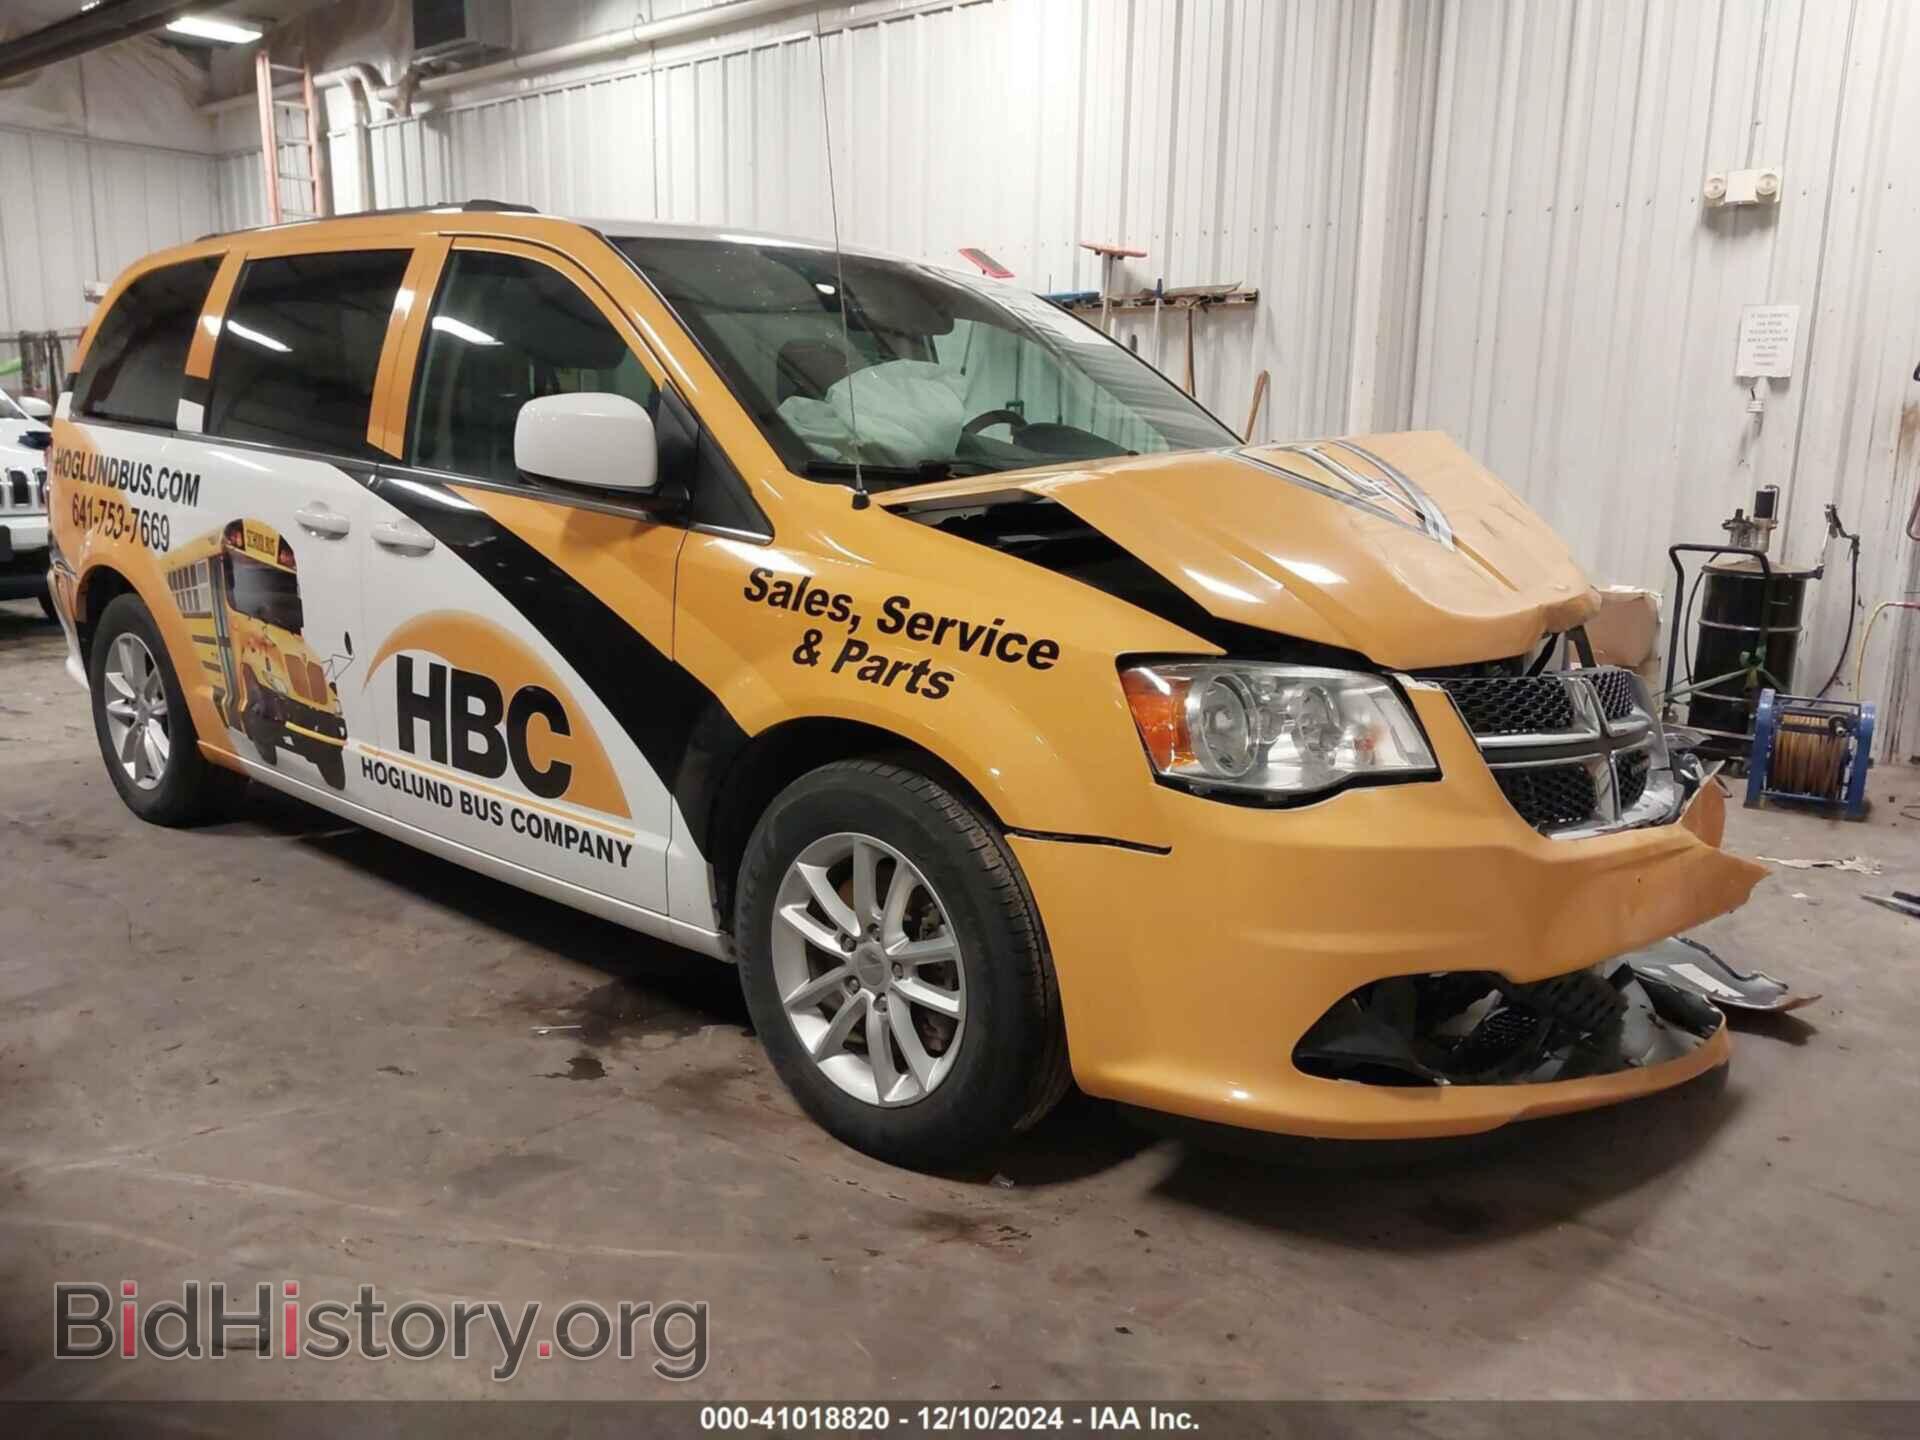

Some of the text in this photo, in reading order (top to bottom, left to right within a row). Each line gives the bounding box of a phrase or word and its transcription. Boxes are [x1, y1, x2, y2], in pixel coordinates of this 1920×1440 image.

[54, 448, 200, 507] HOGLUNDBUS.COM
[72, 493, 170, 552] 641-753-7669
[743, 566, 1060, 670] Sales, Service
[792, 628, 954, 700] & Parts
[396, 654, 572, 799] HBC
[361, 756, 632, 868] HOGLUND BUS COMPANY
